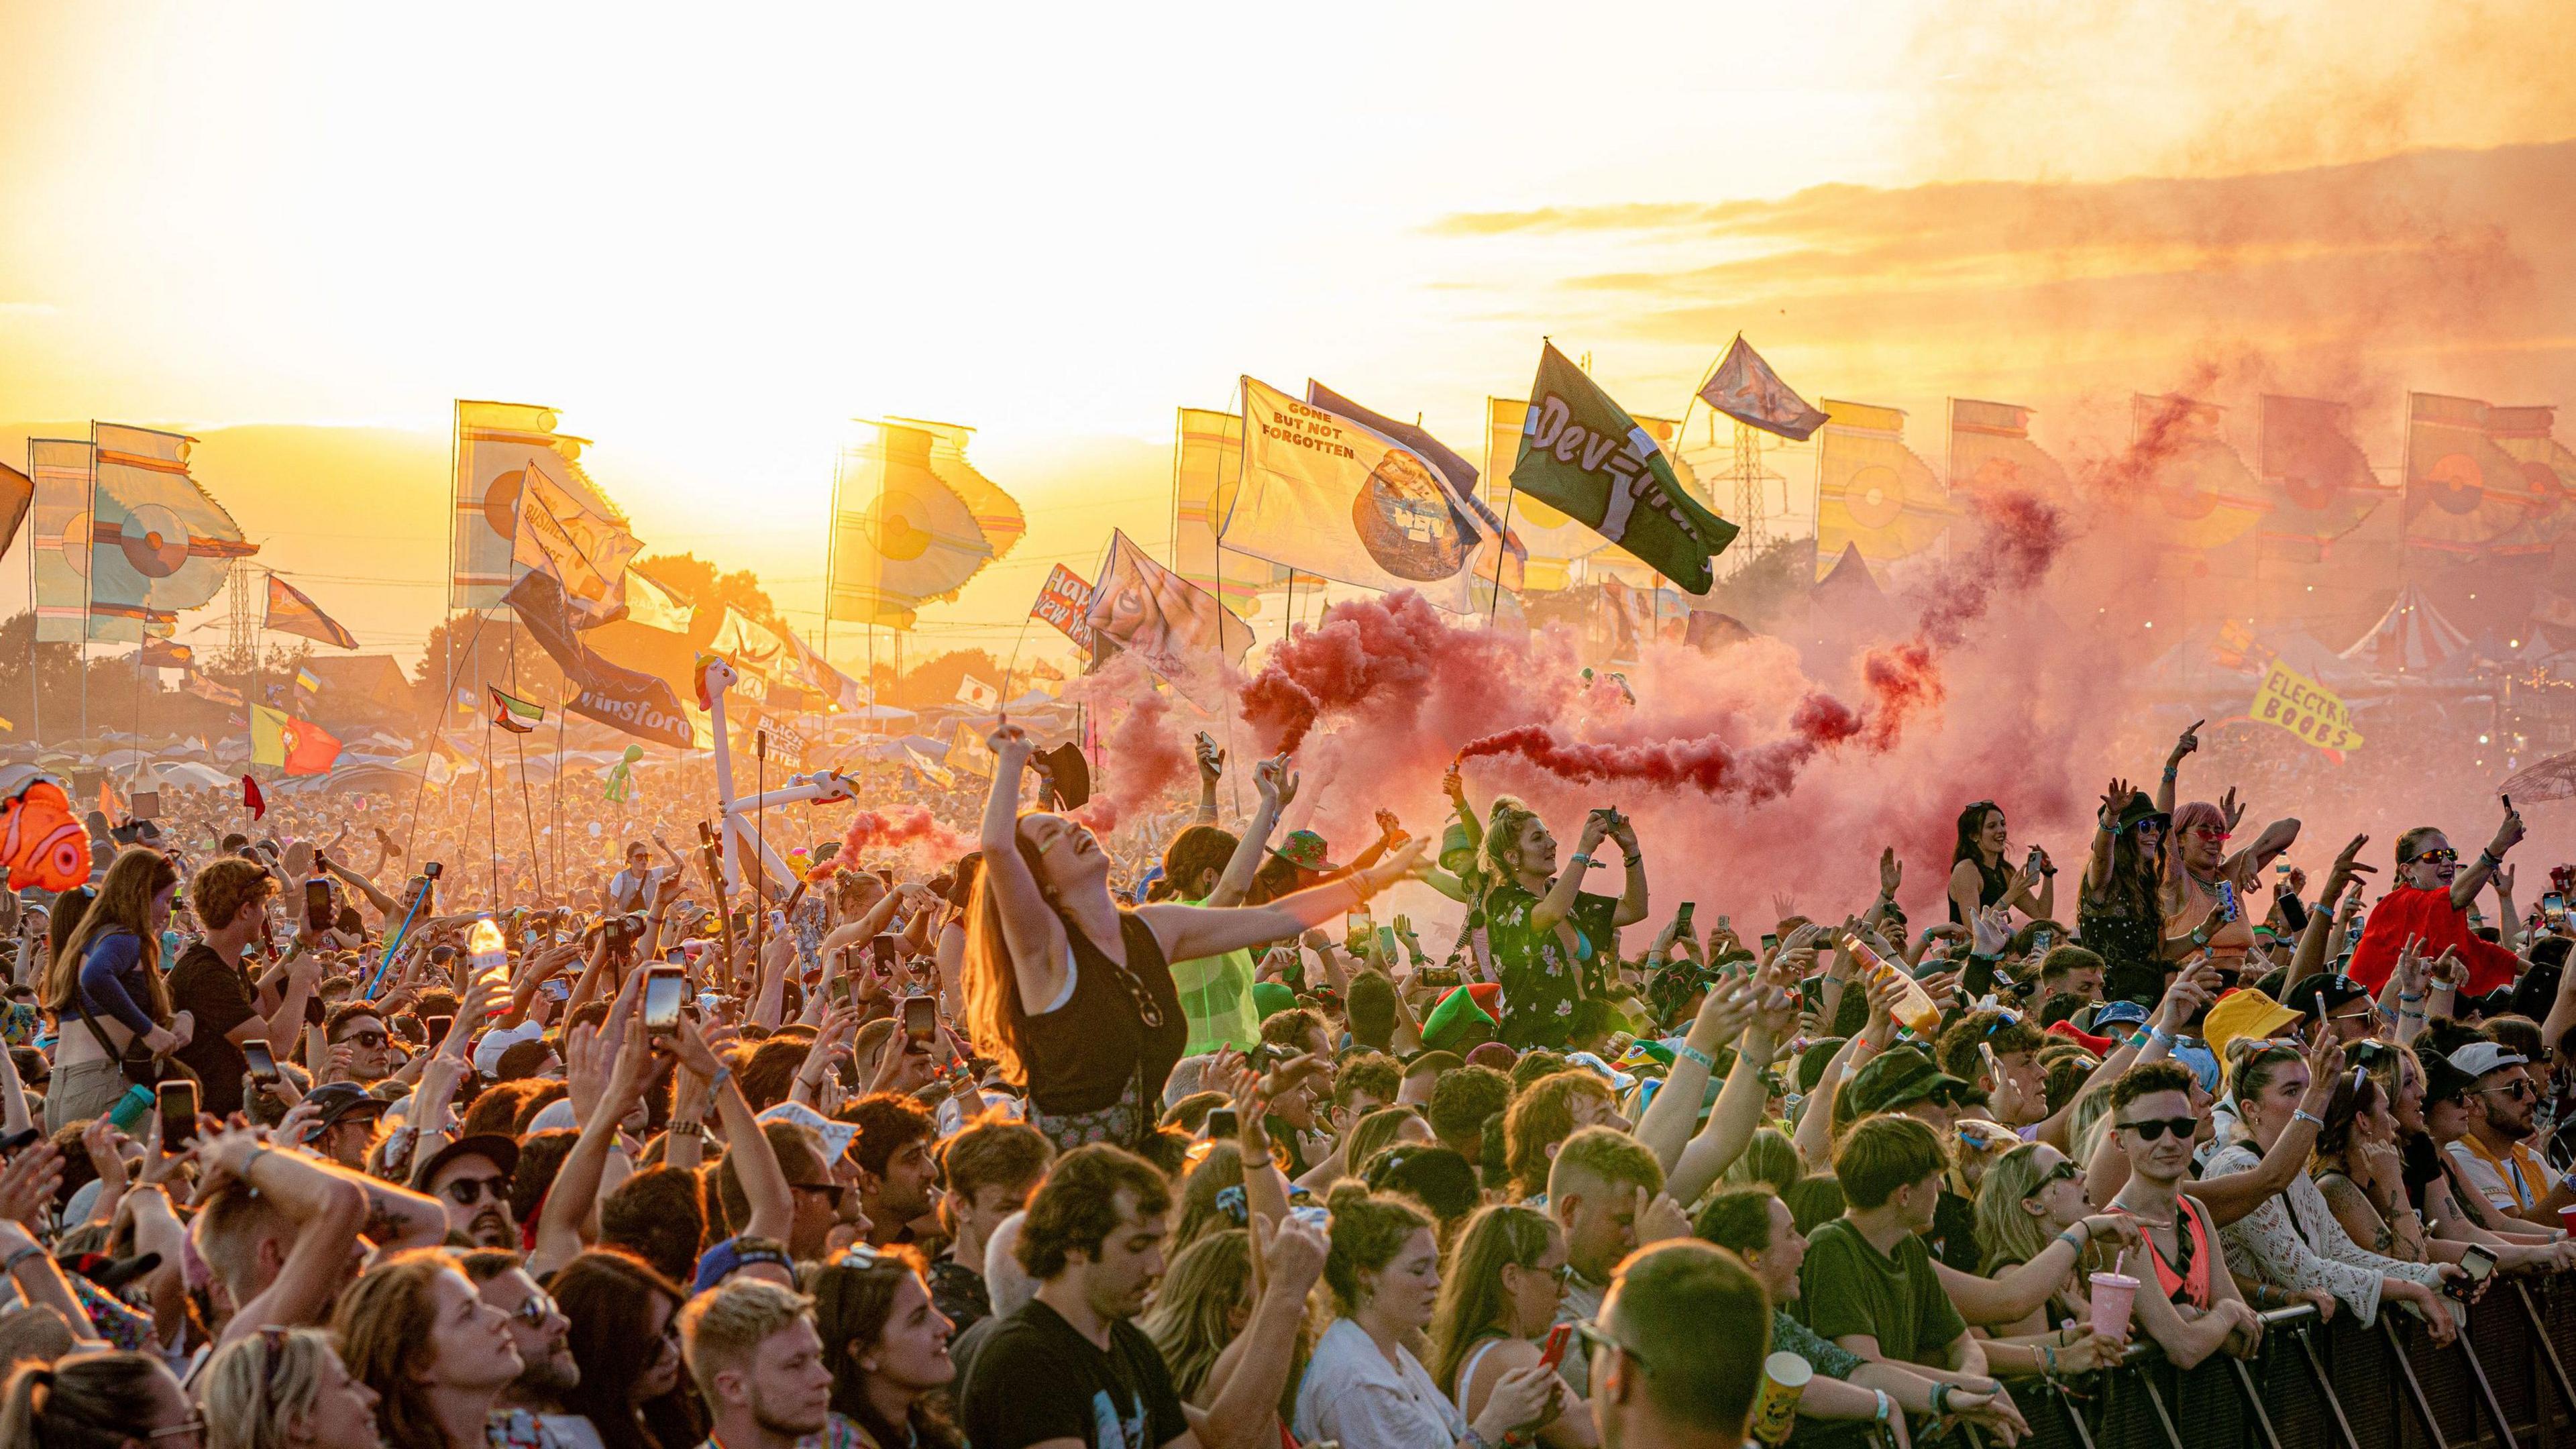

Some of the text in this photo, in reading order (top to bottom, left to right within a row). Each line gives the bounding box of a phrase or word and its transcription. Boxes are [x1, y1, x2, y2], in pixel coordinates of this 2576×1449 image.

[1274, 412, 1342, 439] BUT NOT
[1289, 403, 1332, 423] GONE
[1263, 423, 1354, 460] FORGOTTEN
[525, 503, 578, 547] BUSINESS
[2264, 697, 2348, 747] BOOBS
[749, 742, 801, 768] MTTER
